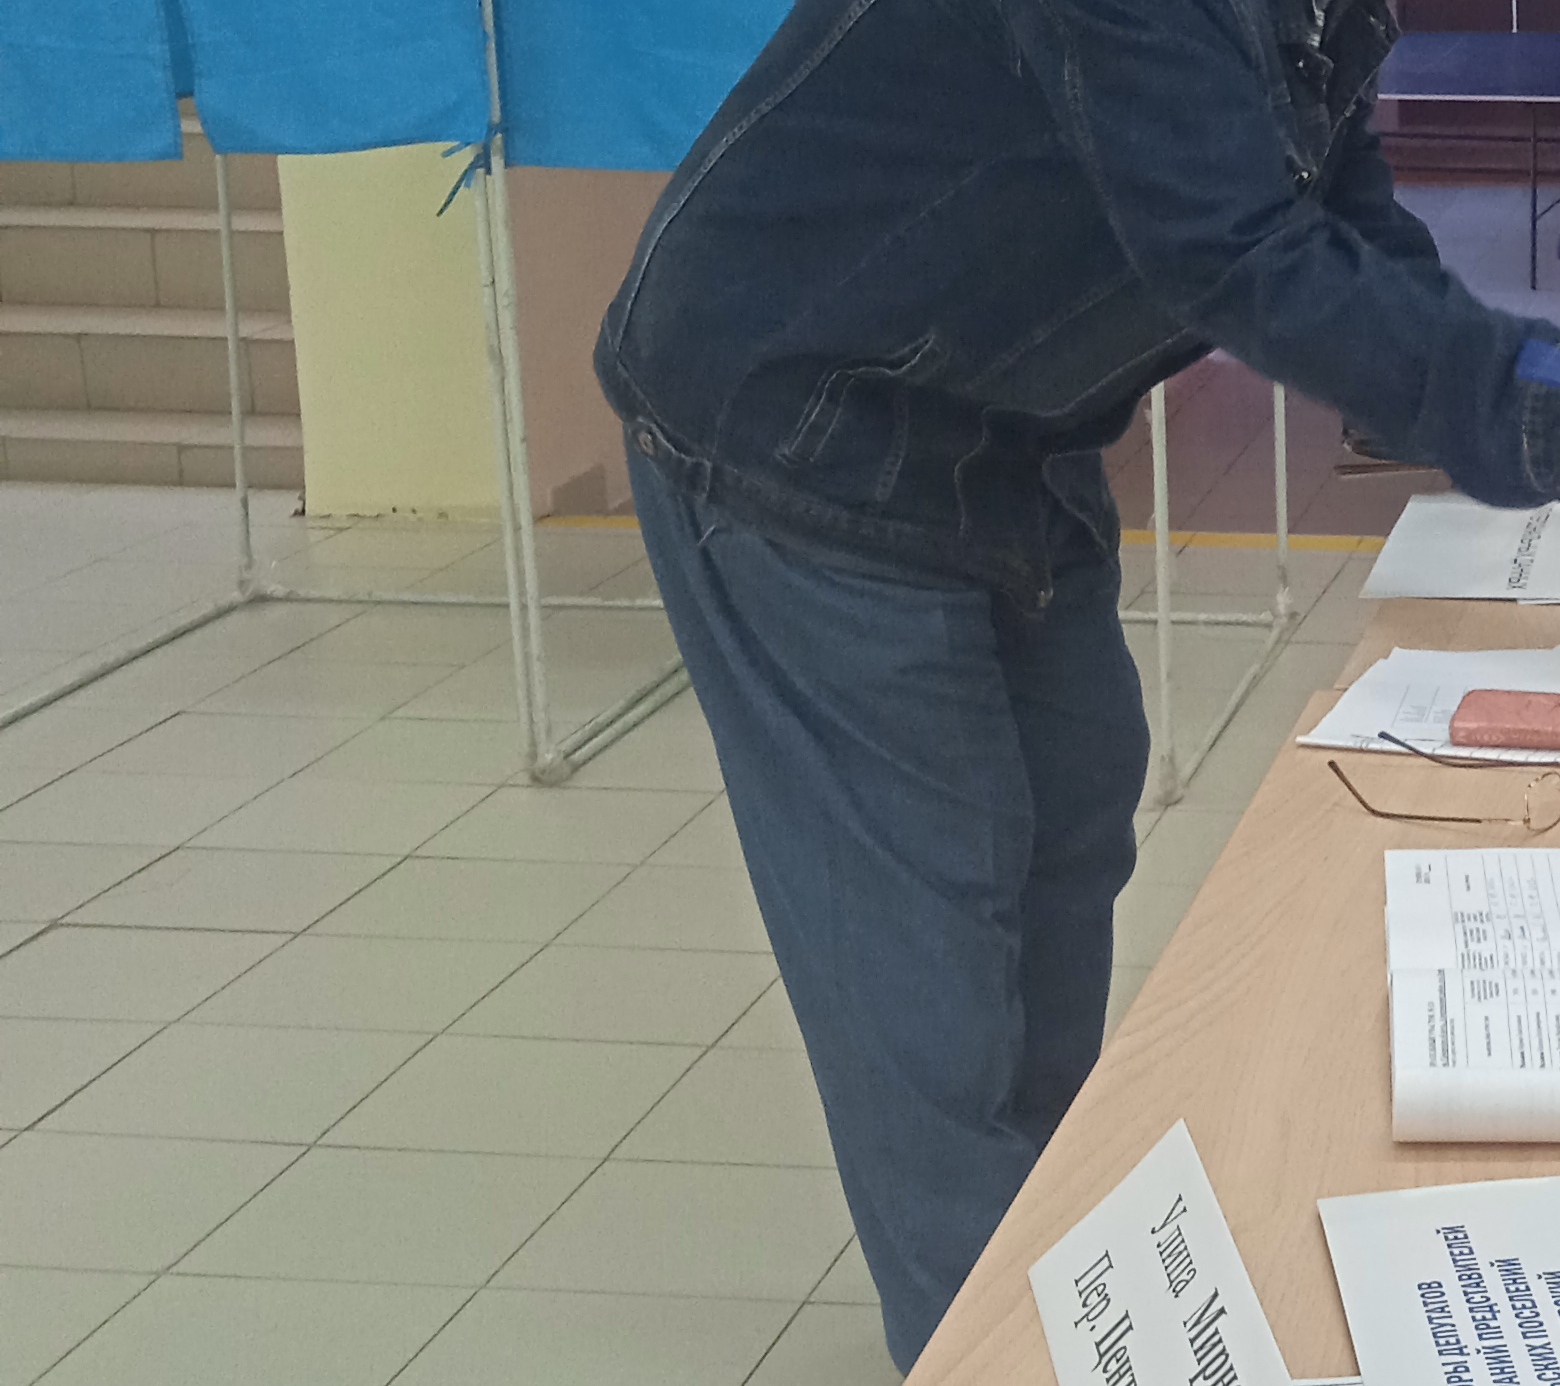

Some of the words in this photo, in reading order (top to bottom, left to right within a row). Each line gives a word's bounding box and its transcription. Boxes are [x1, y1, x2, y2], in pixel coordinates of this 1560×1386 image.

[1151, 1193, 1197, 1298] Улица
[1435, 1225, 1504, 1341] ПРЕДСТАВИТЕЛЕЙ
[1074, 1250, 1114, 1332] Пер.
[1417, 1281, 1470, 1356] ДЕПУТАТОВ
[1489, 1258, 1548, 1339] ПОСЕЛЕНИЙ
